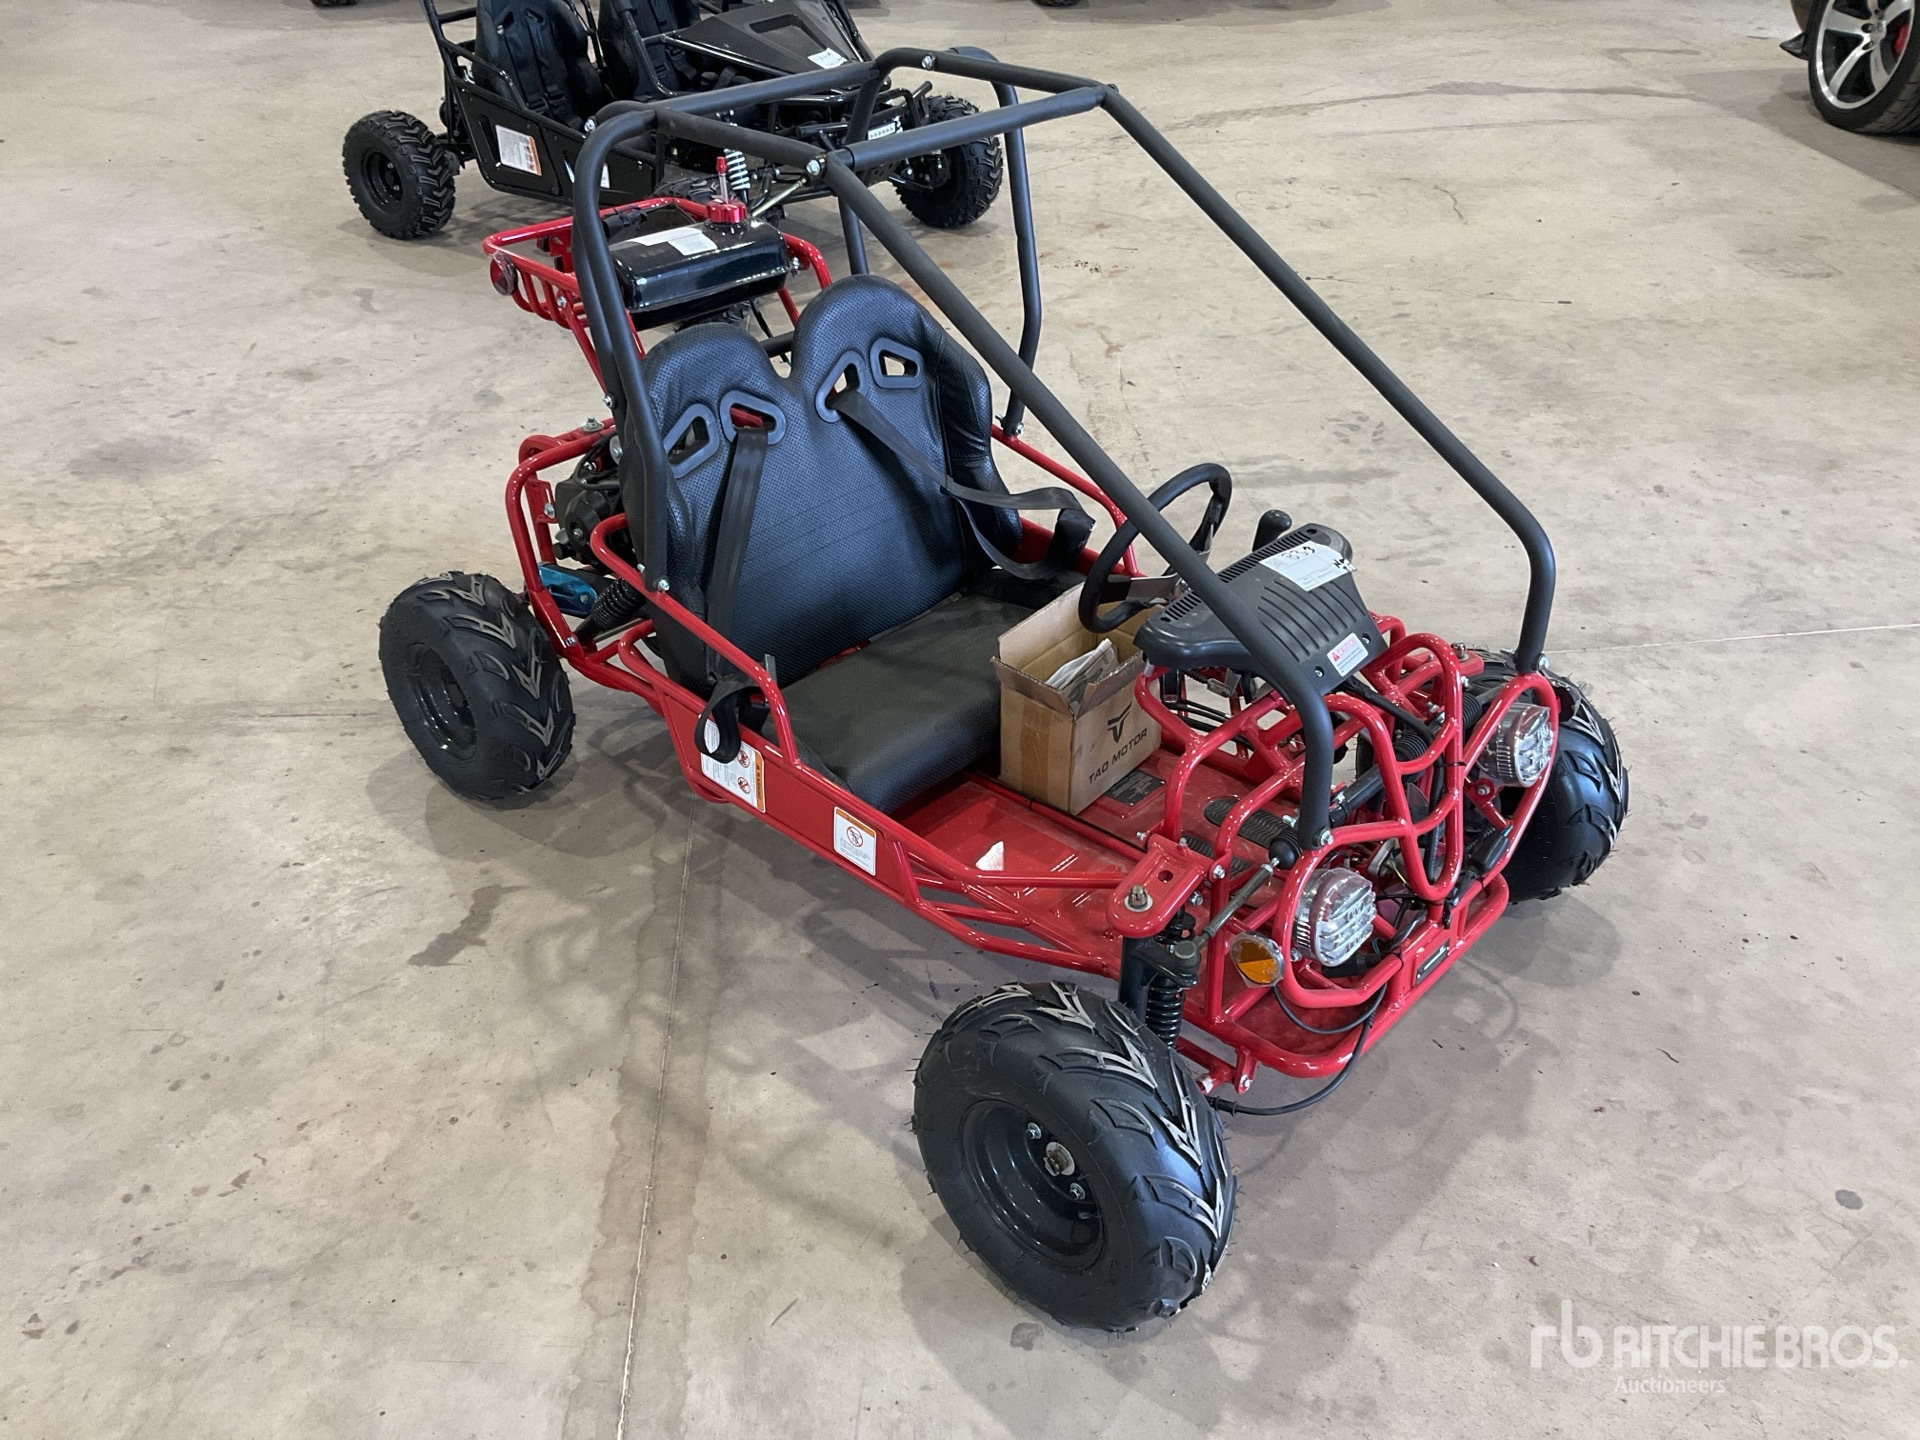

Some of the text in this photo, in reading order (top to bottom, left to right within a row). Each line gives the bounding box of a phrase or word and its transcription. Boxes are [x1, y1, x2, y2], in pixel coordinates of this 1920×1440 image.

[1336, 635, 1358, 657] CAUTION
[1088, 728, 1148, 784] TAO MOTOR
